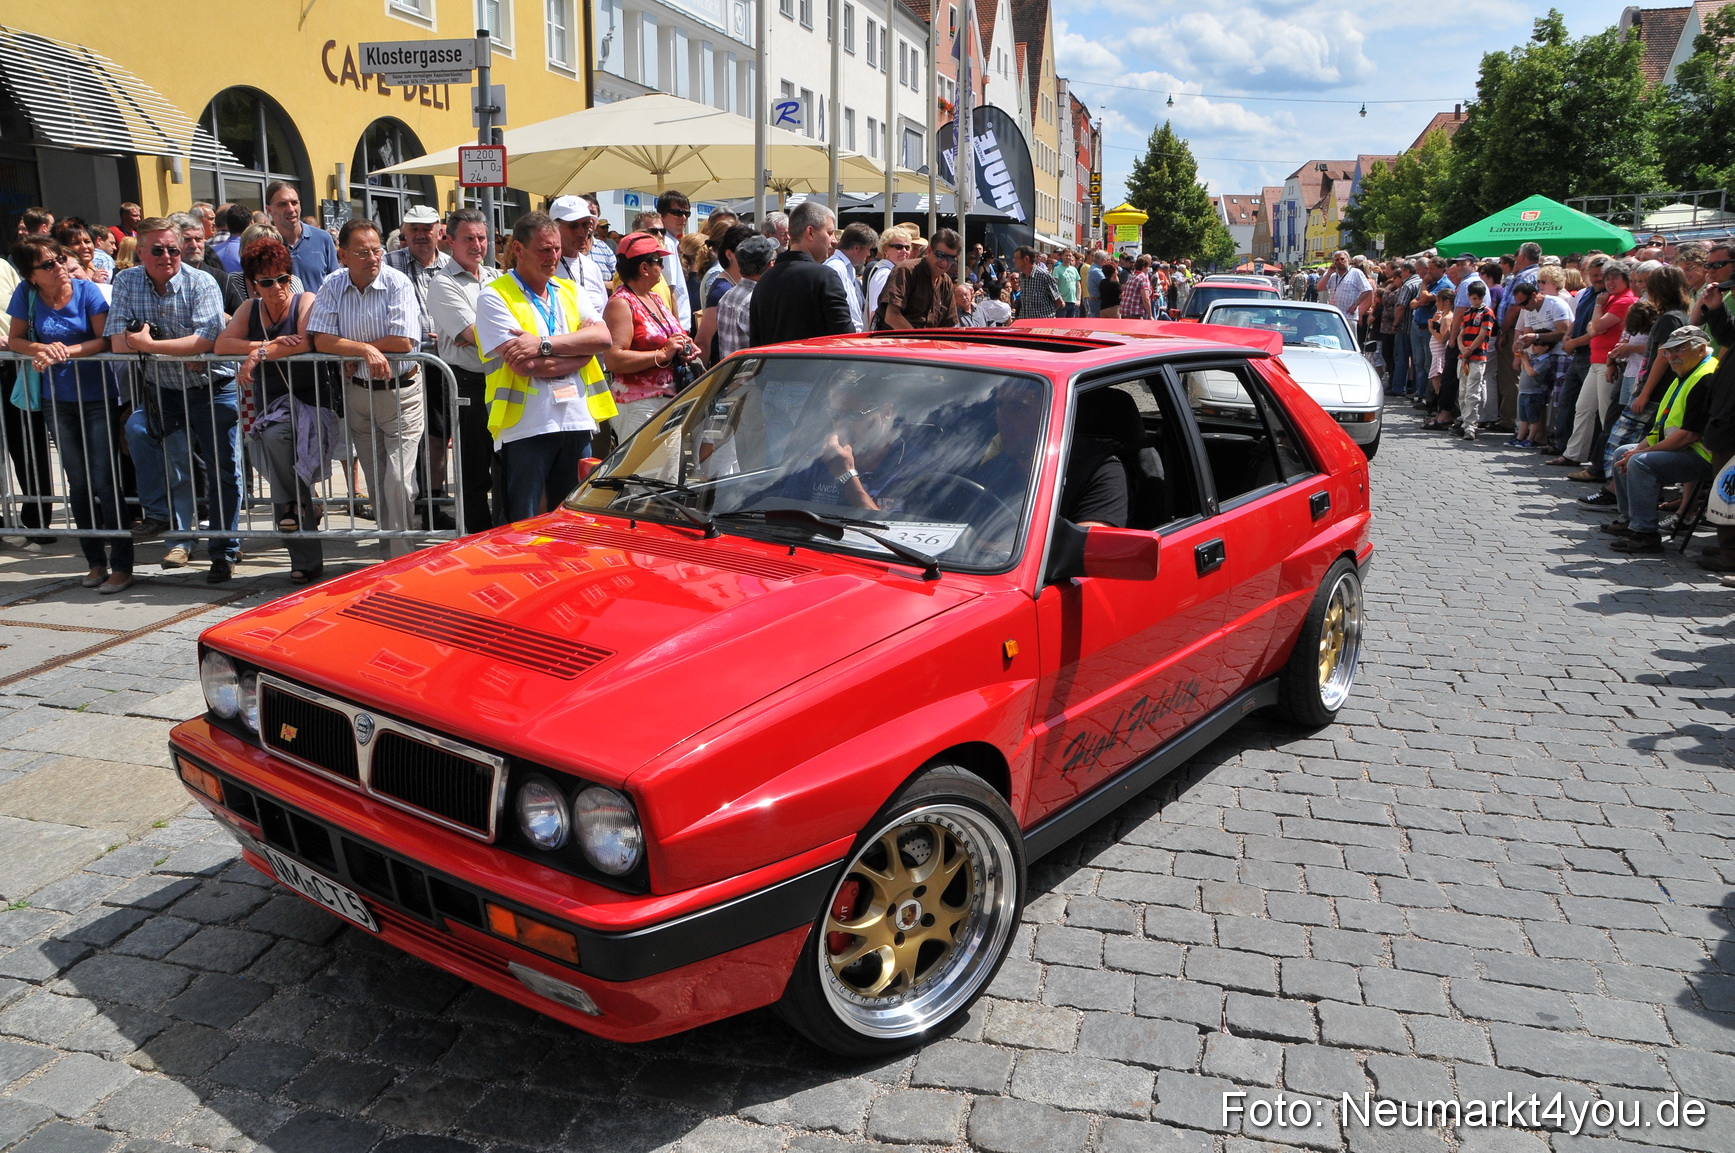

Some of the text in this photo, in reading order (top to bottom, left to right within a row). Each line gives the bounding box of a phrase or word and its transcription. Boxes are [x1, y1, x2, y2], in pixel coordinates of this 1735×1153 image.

[366, 47, 462, 69] Klostergasse
[464, 150, 494, 160] H 200
[1091, 173, 1101, 228] HOTEL
[1489, 225, 1563, 233] Lammsbräu
